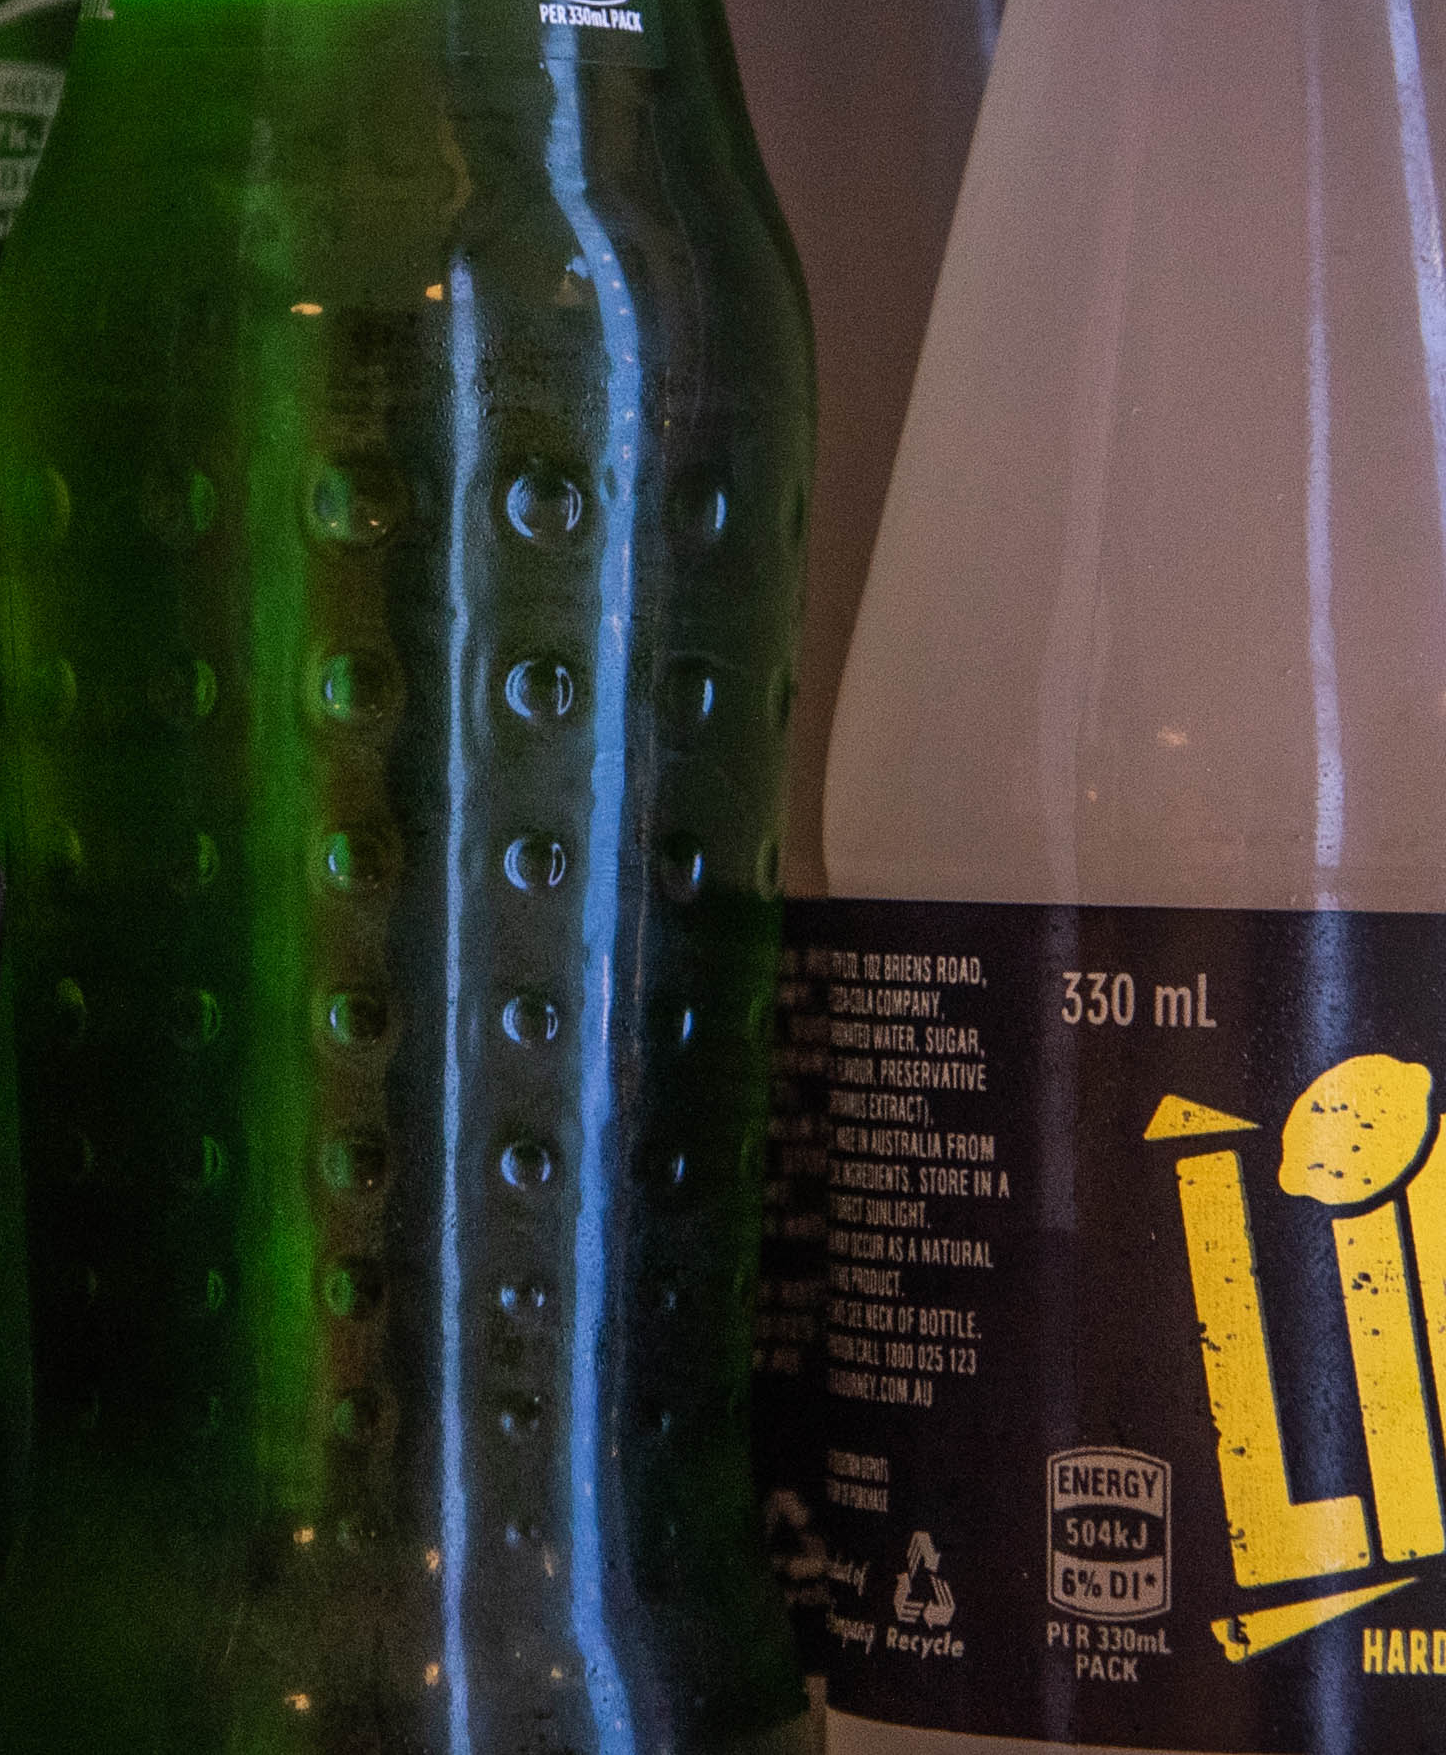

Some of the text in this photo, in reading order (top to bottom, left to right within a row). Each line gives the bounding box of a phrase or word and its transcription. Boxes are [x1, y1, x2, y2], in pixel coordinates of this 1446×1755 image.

[539, 2, 644, 33] PER 330mL PACK
[884, 955, 931, 985] BRIENS
[936, 956, 987, 988] ROAD,
[876, 990, 945, 1021] COMPANY,
[1062, 972, 1217, 1028] 330 mL
[925, 1026, 986, 1058] SUGAR,
[880, 1059, 987, 1092] PRESERVATIVE
[871, 1129, 942, 1158] AUSTRALIA
[947, 1132, 995, 1162] FROM
[919, 1167, 968, 1195] STORE
[974, 1170, 992, 1197] IN
[998, 1171, 1010, 1198] A
[921, 1239, 994, 1269] NATURAL
[865, 1303, 893, 1332] NECK
[898, 1306, 914, 1334] OF
[918, 1344, 943, 1372] 025
[950, 1348, 976, 1376] 123
[1058, 1465, 1159, 1499] ENERGY
[1066, 1518, 1148, 1550] 504kJ
[1062, 1567, 1102, 1597] 6%
[886, 1626, 964, 1660] Recycle
[1097, 1624, 1172, 1655] 330mL
[1076, 1655, 1138, 1682] PACK
